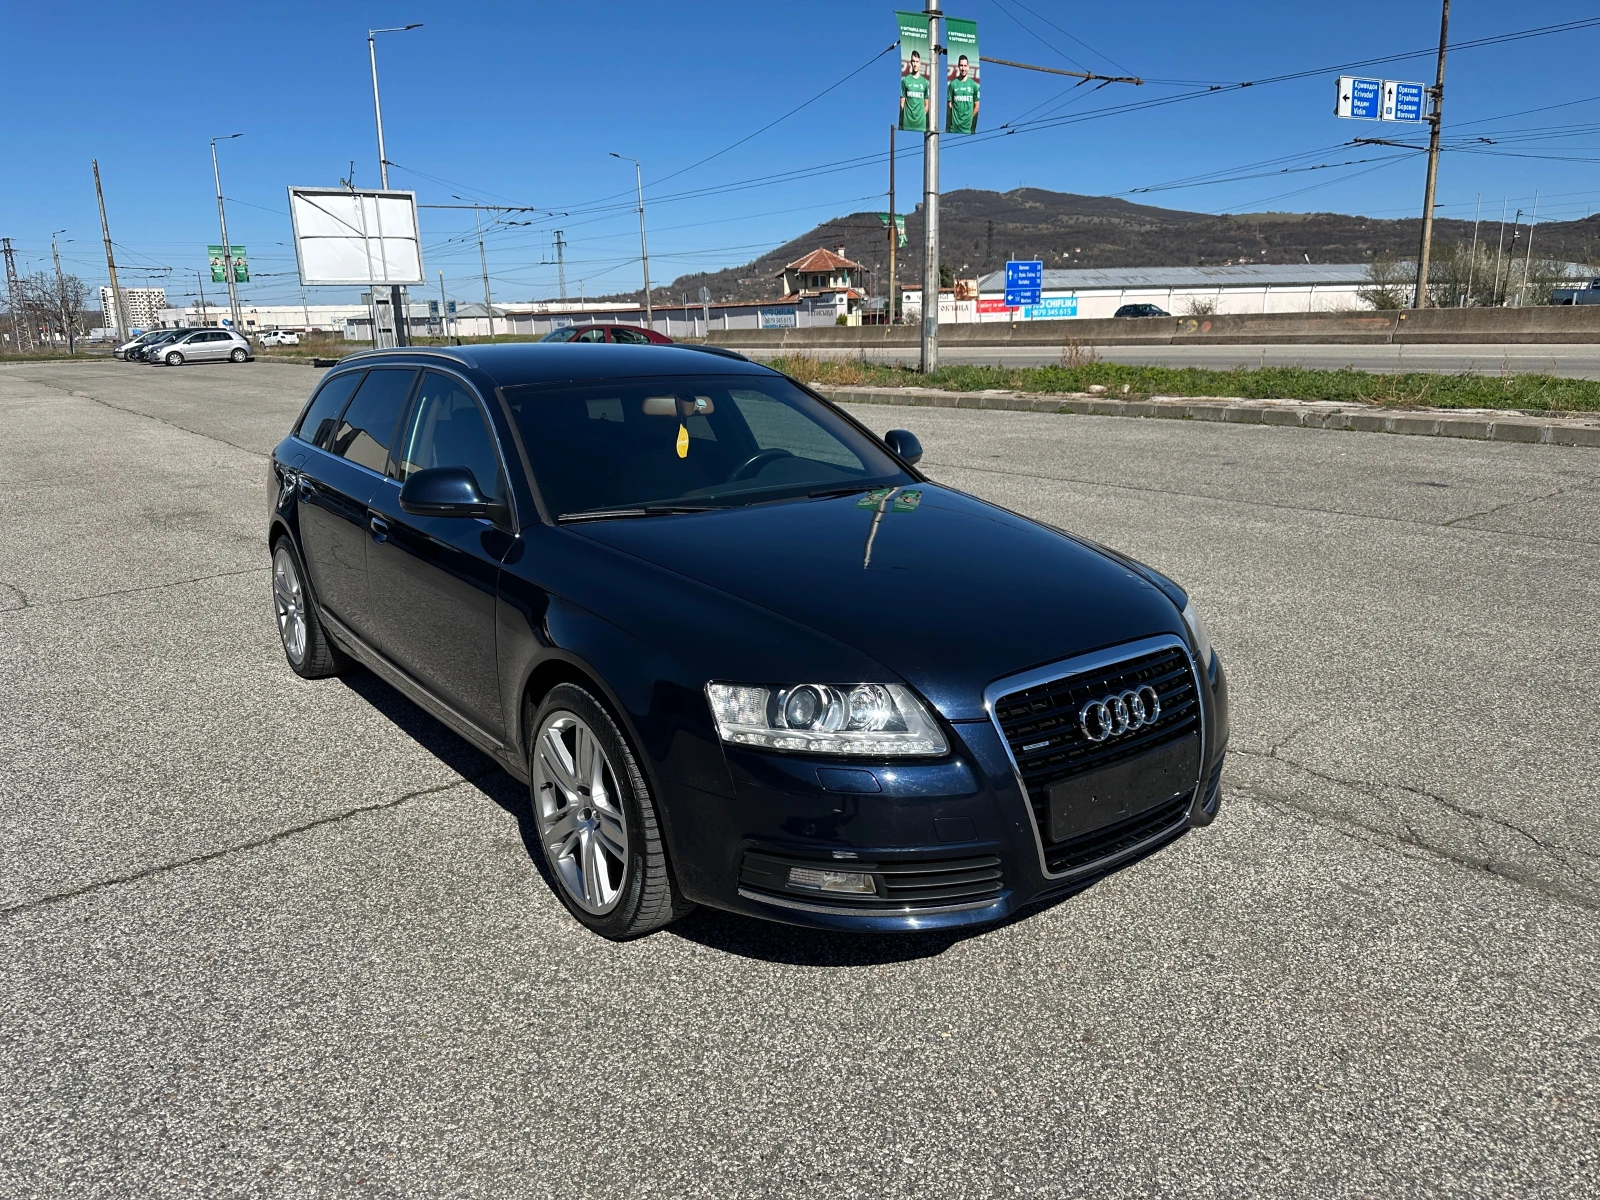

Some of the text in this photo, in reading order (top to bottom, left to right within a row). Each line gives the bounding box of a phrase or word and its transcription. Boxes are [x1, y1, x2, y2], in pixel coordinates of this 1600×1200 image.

[1399, 86, 1418, 94] Оряхово
[1354, 99, 1369, 107] Видин
[1398, 95, 1419, 103] Oryahovo
[1397, 103, 1417, 111] Борован
[1047, 308, 1058, 316] 345
